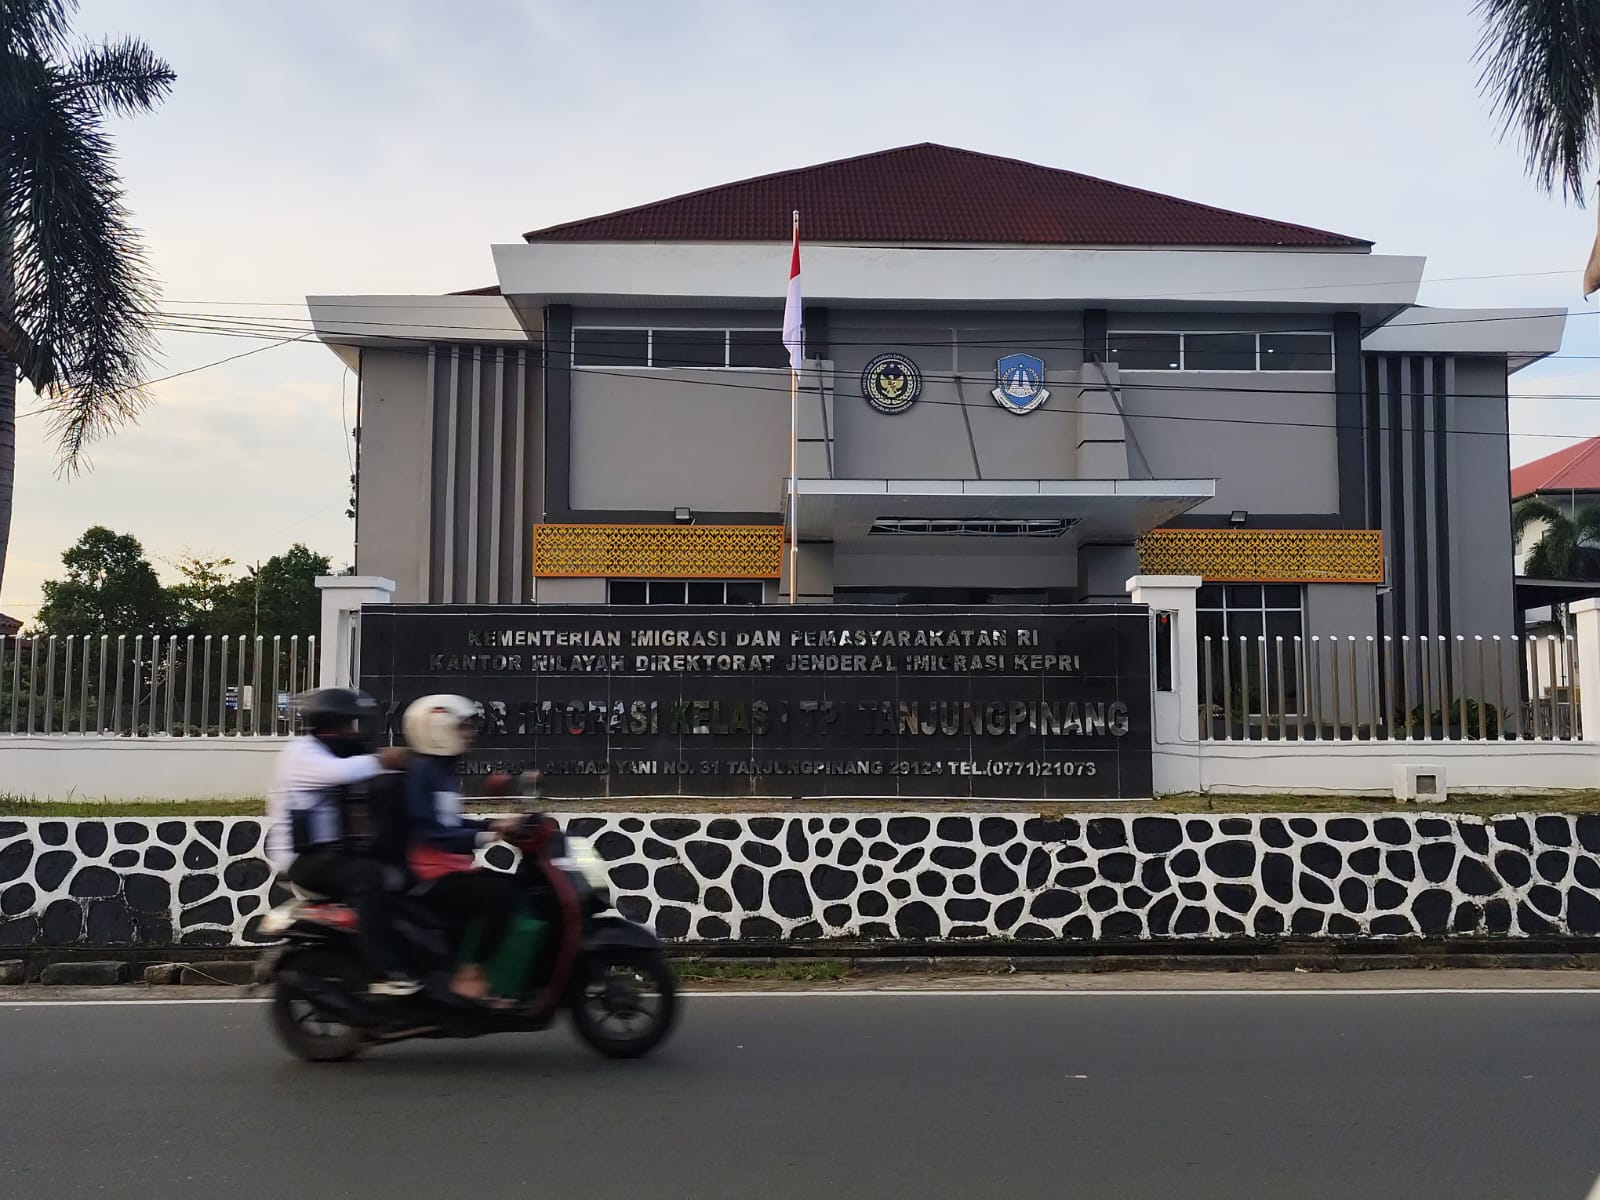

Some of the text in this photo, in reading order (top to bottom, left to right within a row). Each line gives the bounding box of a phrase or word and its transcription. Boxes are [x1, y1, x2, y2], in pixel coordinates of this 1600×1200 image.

[468, 629, 1039, 647] KEMENTERIAN IMIGRASI DAN PEMASYARAKATAN RI
[429, 654, 1080, 672] KANTOR WILAYAH DIREKTORAT JENDERAL IMIGRASI KEPRI
[379, 701, 508, 735] KOR
[518, 701, 659, 735] IMIGRASI
[669, 701, 769, 735] KELAS
[800, 701, 848, 735] TPI
[857, 701, 1130, 736] TANJUNGPINANG
[543, 760, 609, 776] AHMAD
[617, 760, 658, 776] YANI
[663, 760, 694, 776] NO.
[700, 760, 720, 776] 31
[728, 760, 884, 776] TANJUNGPINANG
[889, 760, 943, 776] 29124
